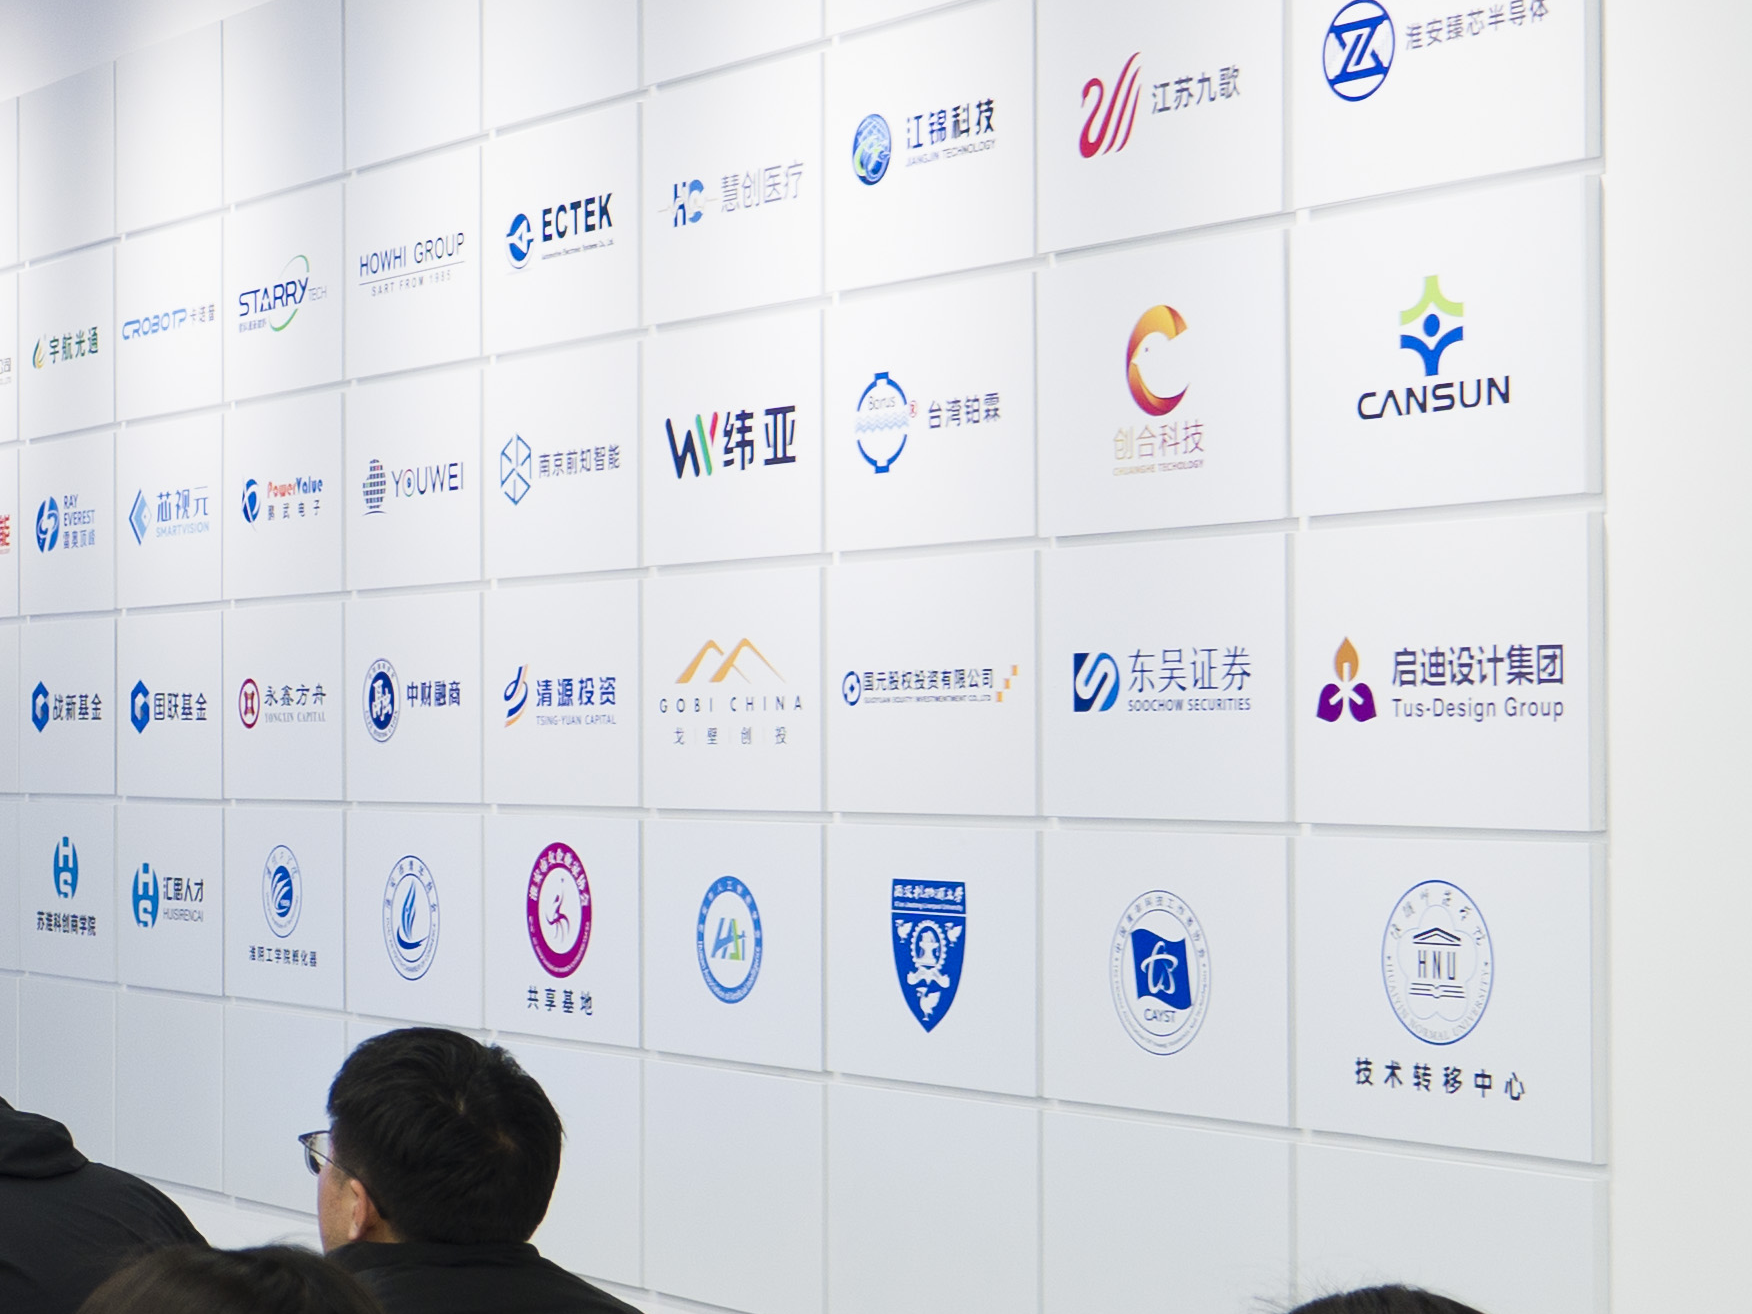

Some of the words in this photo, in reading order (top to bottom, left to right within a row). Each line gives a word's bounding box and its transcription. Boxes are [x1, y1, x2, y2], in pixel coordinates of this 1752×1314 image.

[1150, 65, 1241, 116] 江苏九歌
[906, 98, 995, 151] 江锦科技
[720, 160, 804, 213] 慧创医疗
[542, 192, 613, 242] ECTEK
[360, 245, 406, 278] HOWHI
[413, 232, 464, 264] GROUP
[238, 277, 308, 317] STARRY
[49, 326, 99, 364] 宇航光通
[1357, 375, 1511, 420] CANSUN
[723, 405, 797, 471] 纬亚
[1112, 420, 1204, 461] 创合科技
[538, 444, 622, 479] 南京前知智能
[63, 494, 79, 510] RAY
[267, 476, 324, 498] PowerValue
[63, 509, 96, 527] EVEREST
[156, 486, 209, 523] 芯视元
[156, 521, 210, 538] SMARTVISION
[863, 667, 995, 692] 国元股权投资有限公司
[1127, 645, 1252, 693] 东吴证券
[1392, 644, 1565, 688] 启迪设计集团
[52, 693, 103, 722] 战新基金
[263, 682, 327, 707] 永鑫方舟
[536, 676, 617, 708] 清源投资
[659, 697, 714, 714] GOBI
[729, 695, 804, 713] CHINA
[1127, 698, 1184, 713] SOOCHOW
[1187, 696, 1252, 712] SECURITIES
[584, 714, 617, 726] CAPITAL
[1392, 696, 1498, 722] Tus-Design
[1504, 697, 1565, 723] Group
[163, 876, 205, 903] 汇思人才
[1417, 949, 1457, 981] HNU
[1143, 1008, 1177, 1023] CAYST
[1355, 1056, 1526, 1101] 技术转移中心
